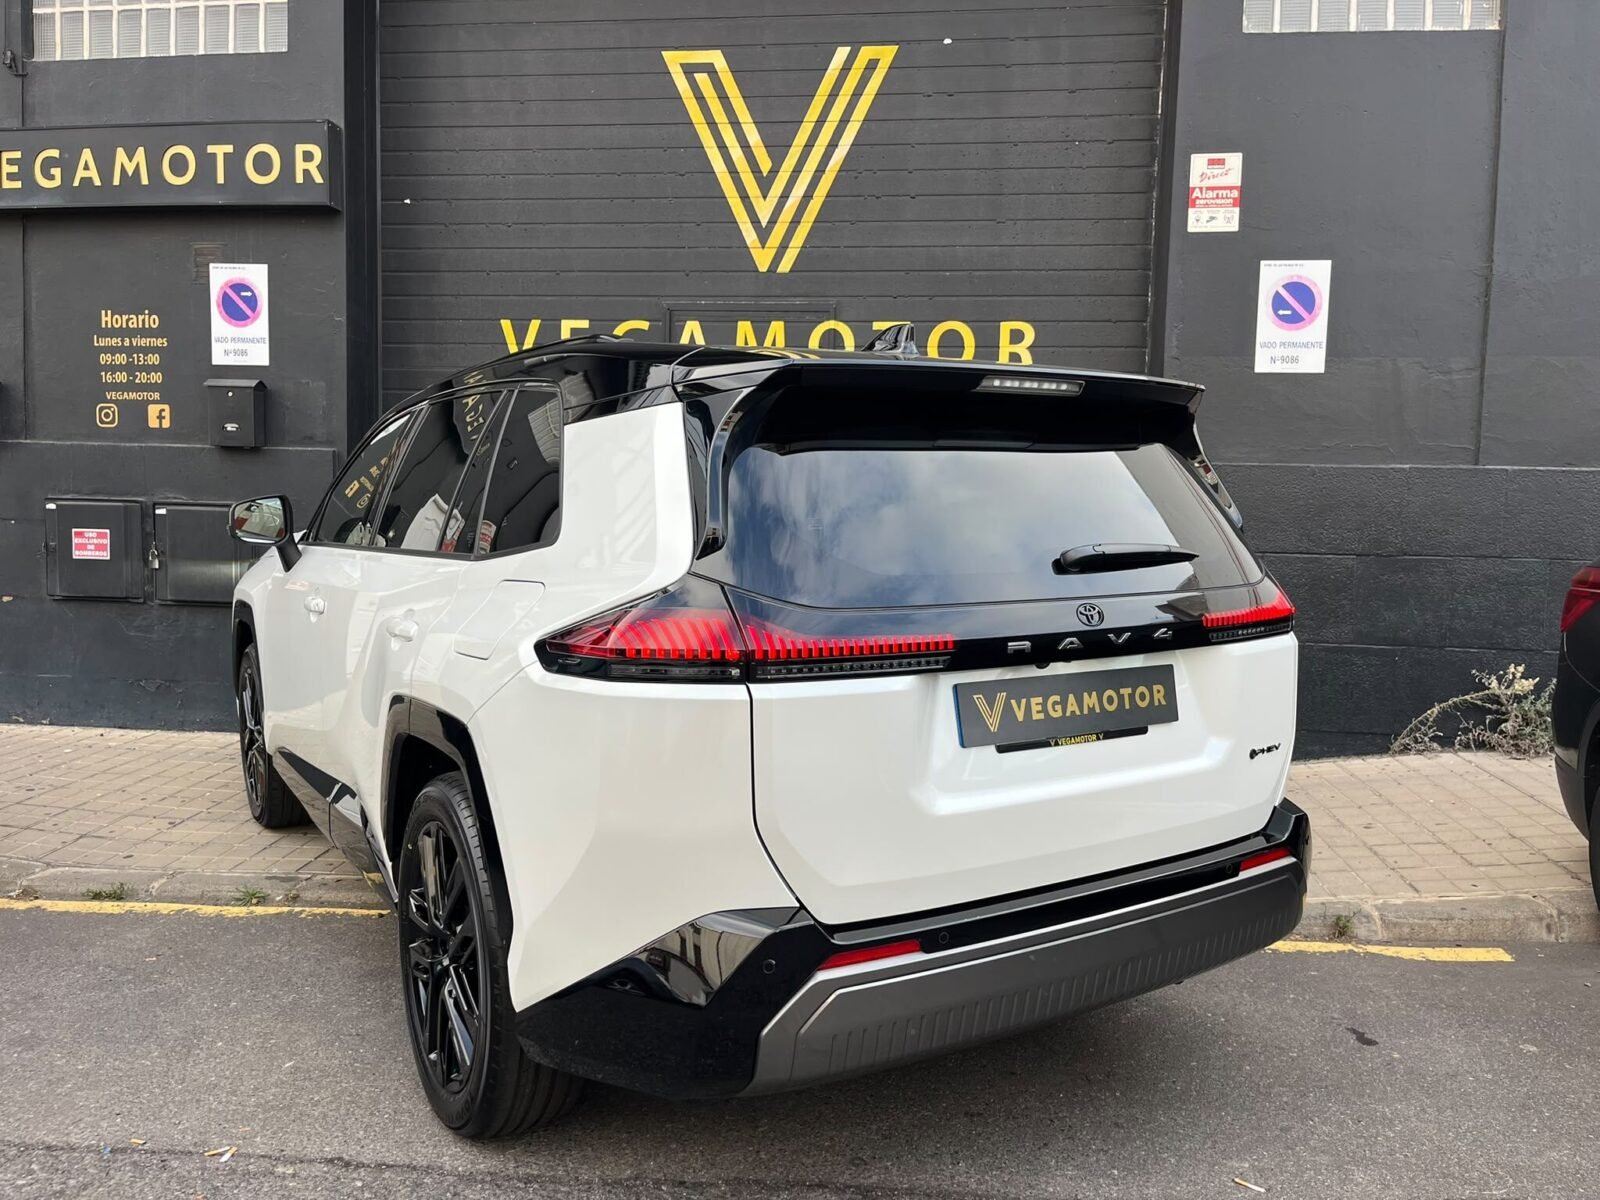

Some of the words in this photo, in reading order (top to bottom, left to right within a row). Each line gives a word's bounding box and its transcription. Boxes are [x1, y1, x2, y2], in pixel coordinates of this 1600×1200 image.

[0, 143, 325, 189] EGAMOTOR
[1192, 187, 1239, 199] Alarma
[101, 310, 159, 329] Horario
[93, 334, 122, 347] Lunes
[123, 337, 129, 347] a
[131, 334, 168, 347] viernes
[214, 336, 229, 344] VADO
[230, 336, 267, 345] PERMANENTE
[1259, 341, 1277, 349] VADO
[1279, 341, 1324, 349] PERMANENTE
[100, 353, 127, 365] 09:00
[100, 371, 127, 383] 16:00
[135, 371, 163, 383] 20:00
[106, 391, 161, 401] VEGAMOTOR
[75, 537, 107, 545] EXCLUSIVO
[1007, 628, 1174, 654] RAV4
[1011, 684, 1167, 722] VEGAMOTOR
[1057, 733, 1097, 746] VEGAMOTOR
